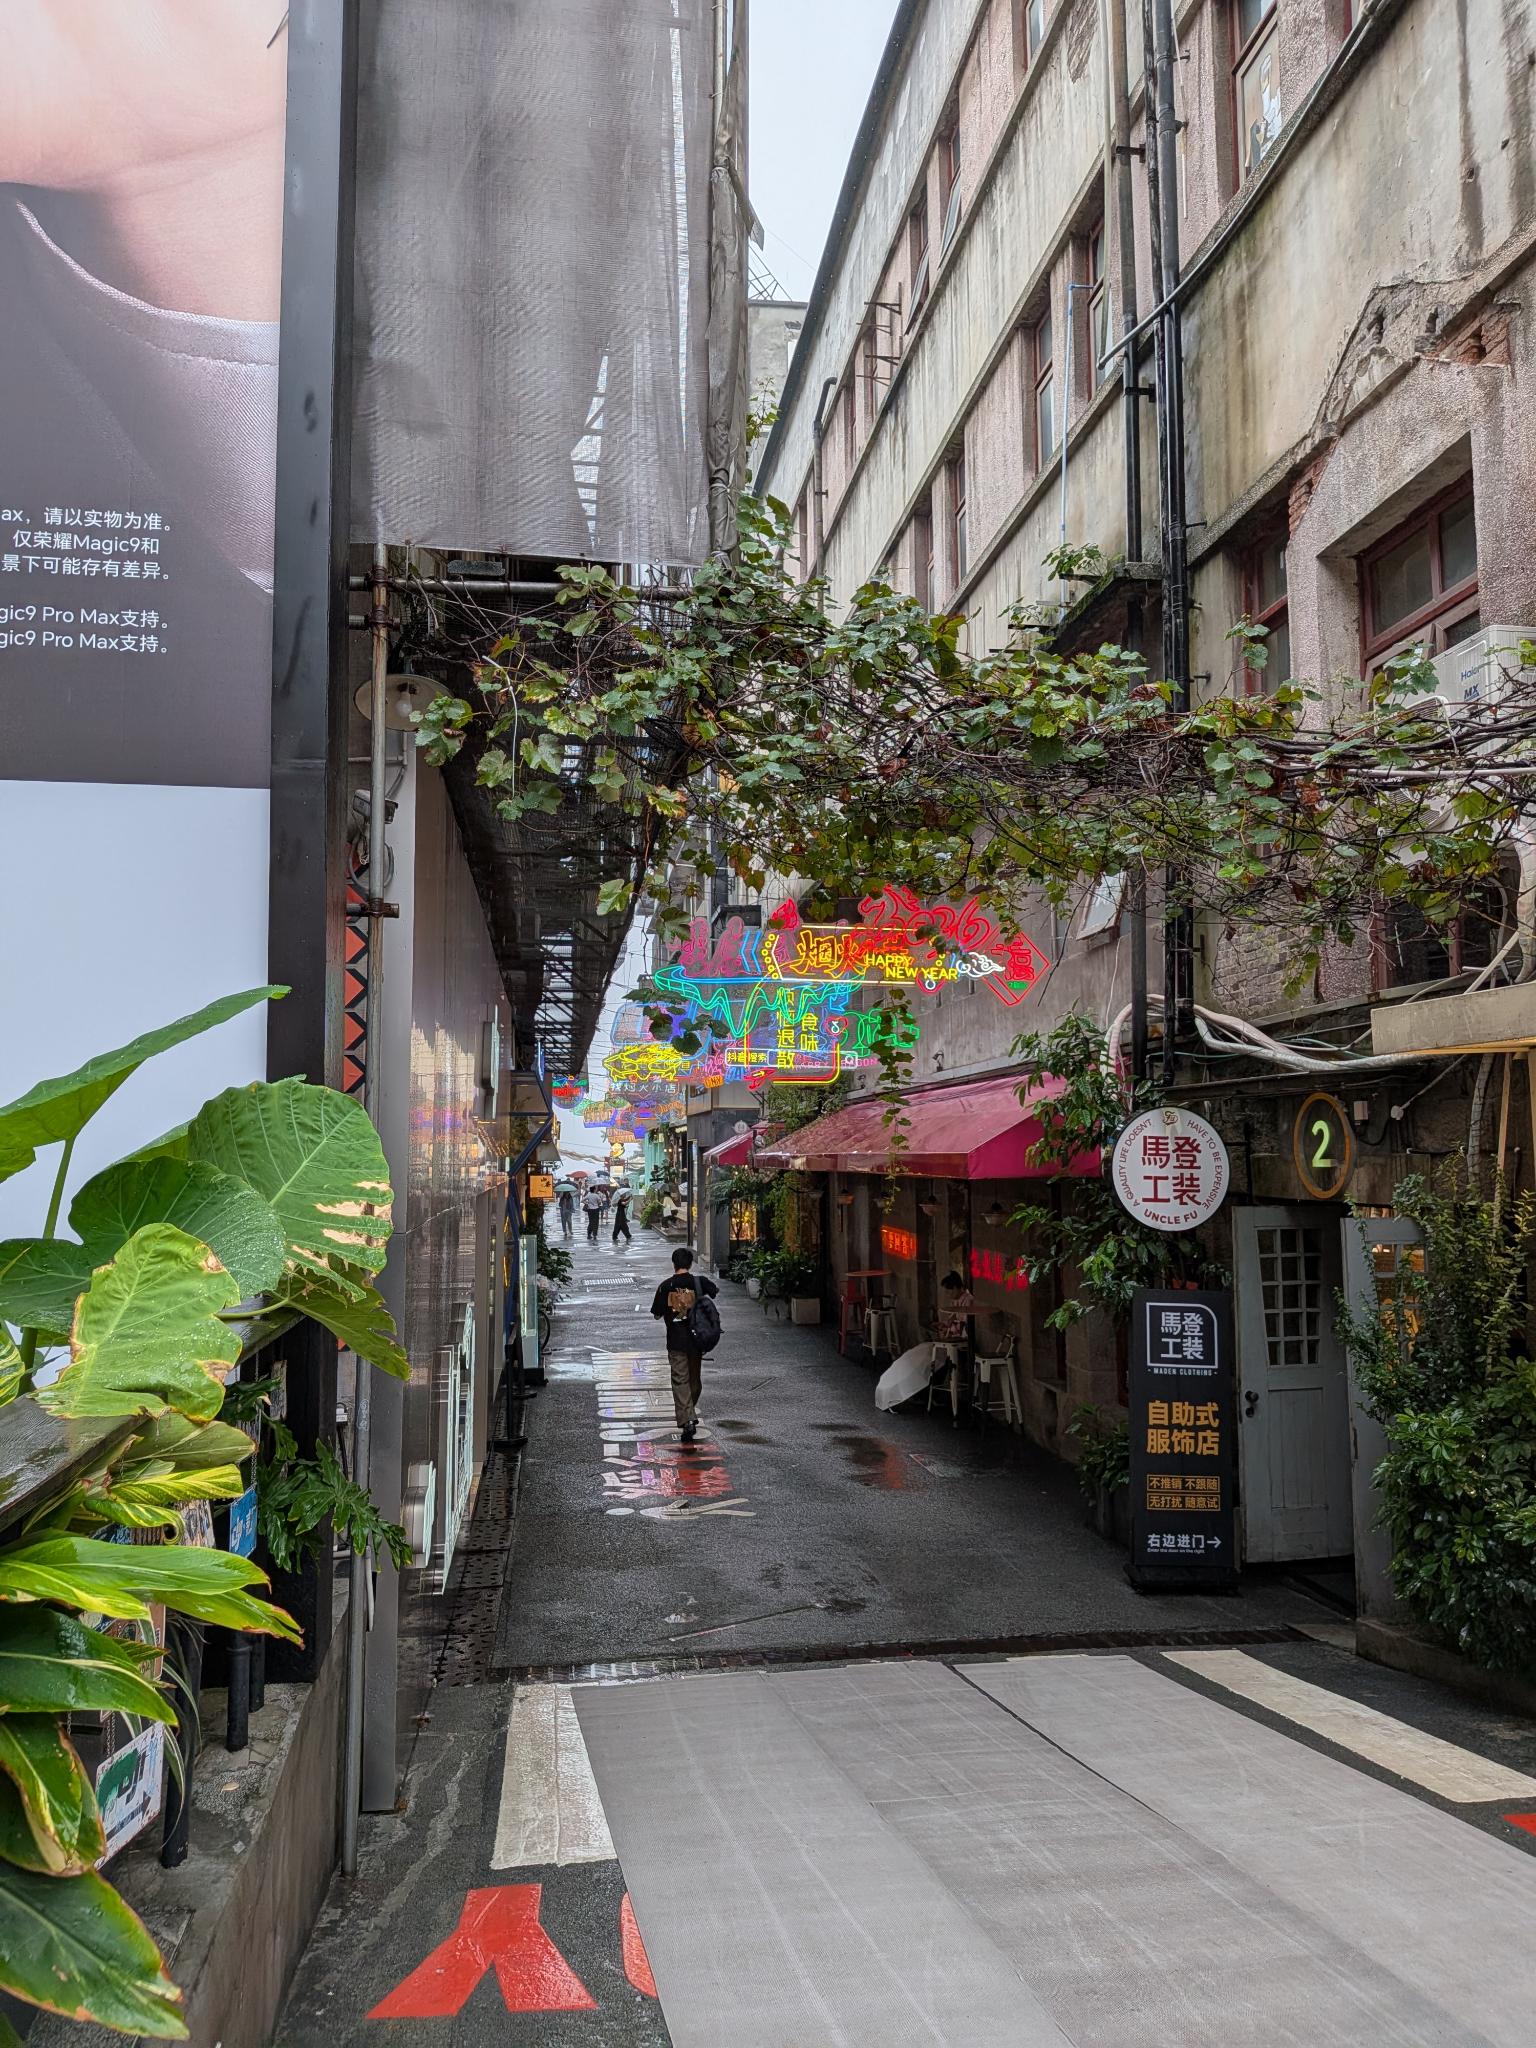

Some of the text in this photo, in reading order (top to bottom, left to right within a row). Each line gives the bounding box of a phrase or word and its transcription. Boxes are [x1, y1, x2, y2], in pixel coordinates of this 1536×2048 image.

[12, 530, 160, 555] 仅荣耀Magic9和
[42, 606, 75, 623] Pro
[80, 608, 168, 629] Max支持。
[42, 631, 74, 648] Pro
[79, 633, 168, 653] Max支持。
[866, 953, 912, 967] HAPPY
[885, 966, 958, 981] NEW YEAR
[1186, 1119, 1209, 1138] HAVE
[1141, 1135, 1203, 1170] 馬登
[1206, 1136, 1217, 1150] TO
[1311, 1119, 1335, 1169] 2
[1120, 1147, 1130, 1162] LIFE
[1212, 1151, 1222, 1163] BE
[1119, 1165, 1134, 1200] QUALITY
[1141, 1172, 1203, 1207] 工装
[1201, 1164, 1223, 1210] EXPENSIVE
[1133, 1199, 1141, 1207] A
[1143, 1208, 1199, 1225] UNCLE FU
[1160, 1311, 1204, 1336] 馬登
[1160, 1336, 1204, 1360] 工装
[1147, 1400, 1220, 1428] 自助式
[1146, 1428, 1220, 1456] 服饰店
[1150, 1477, 1218, 1491] 不推销 不跟随
[1149, 1495, 1218, 1509] 无打扰 随意试
[1147, 1533, 1205, 1549] 右边进门
